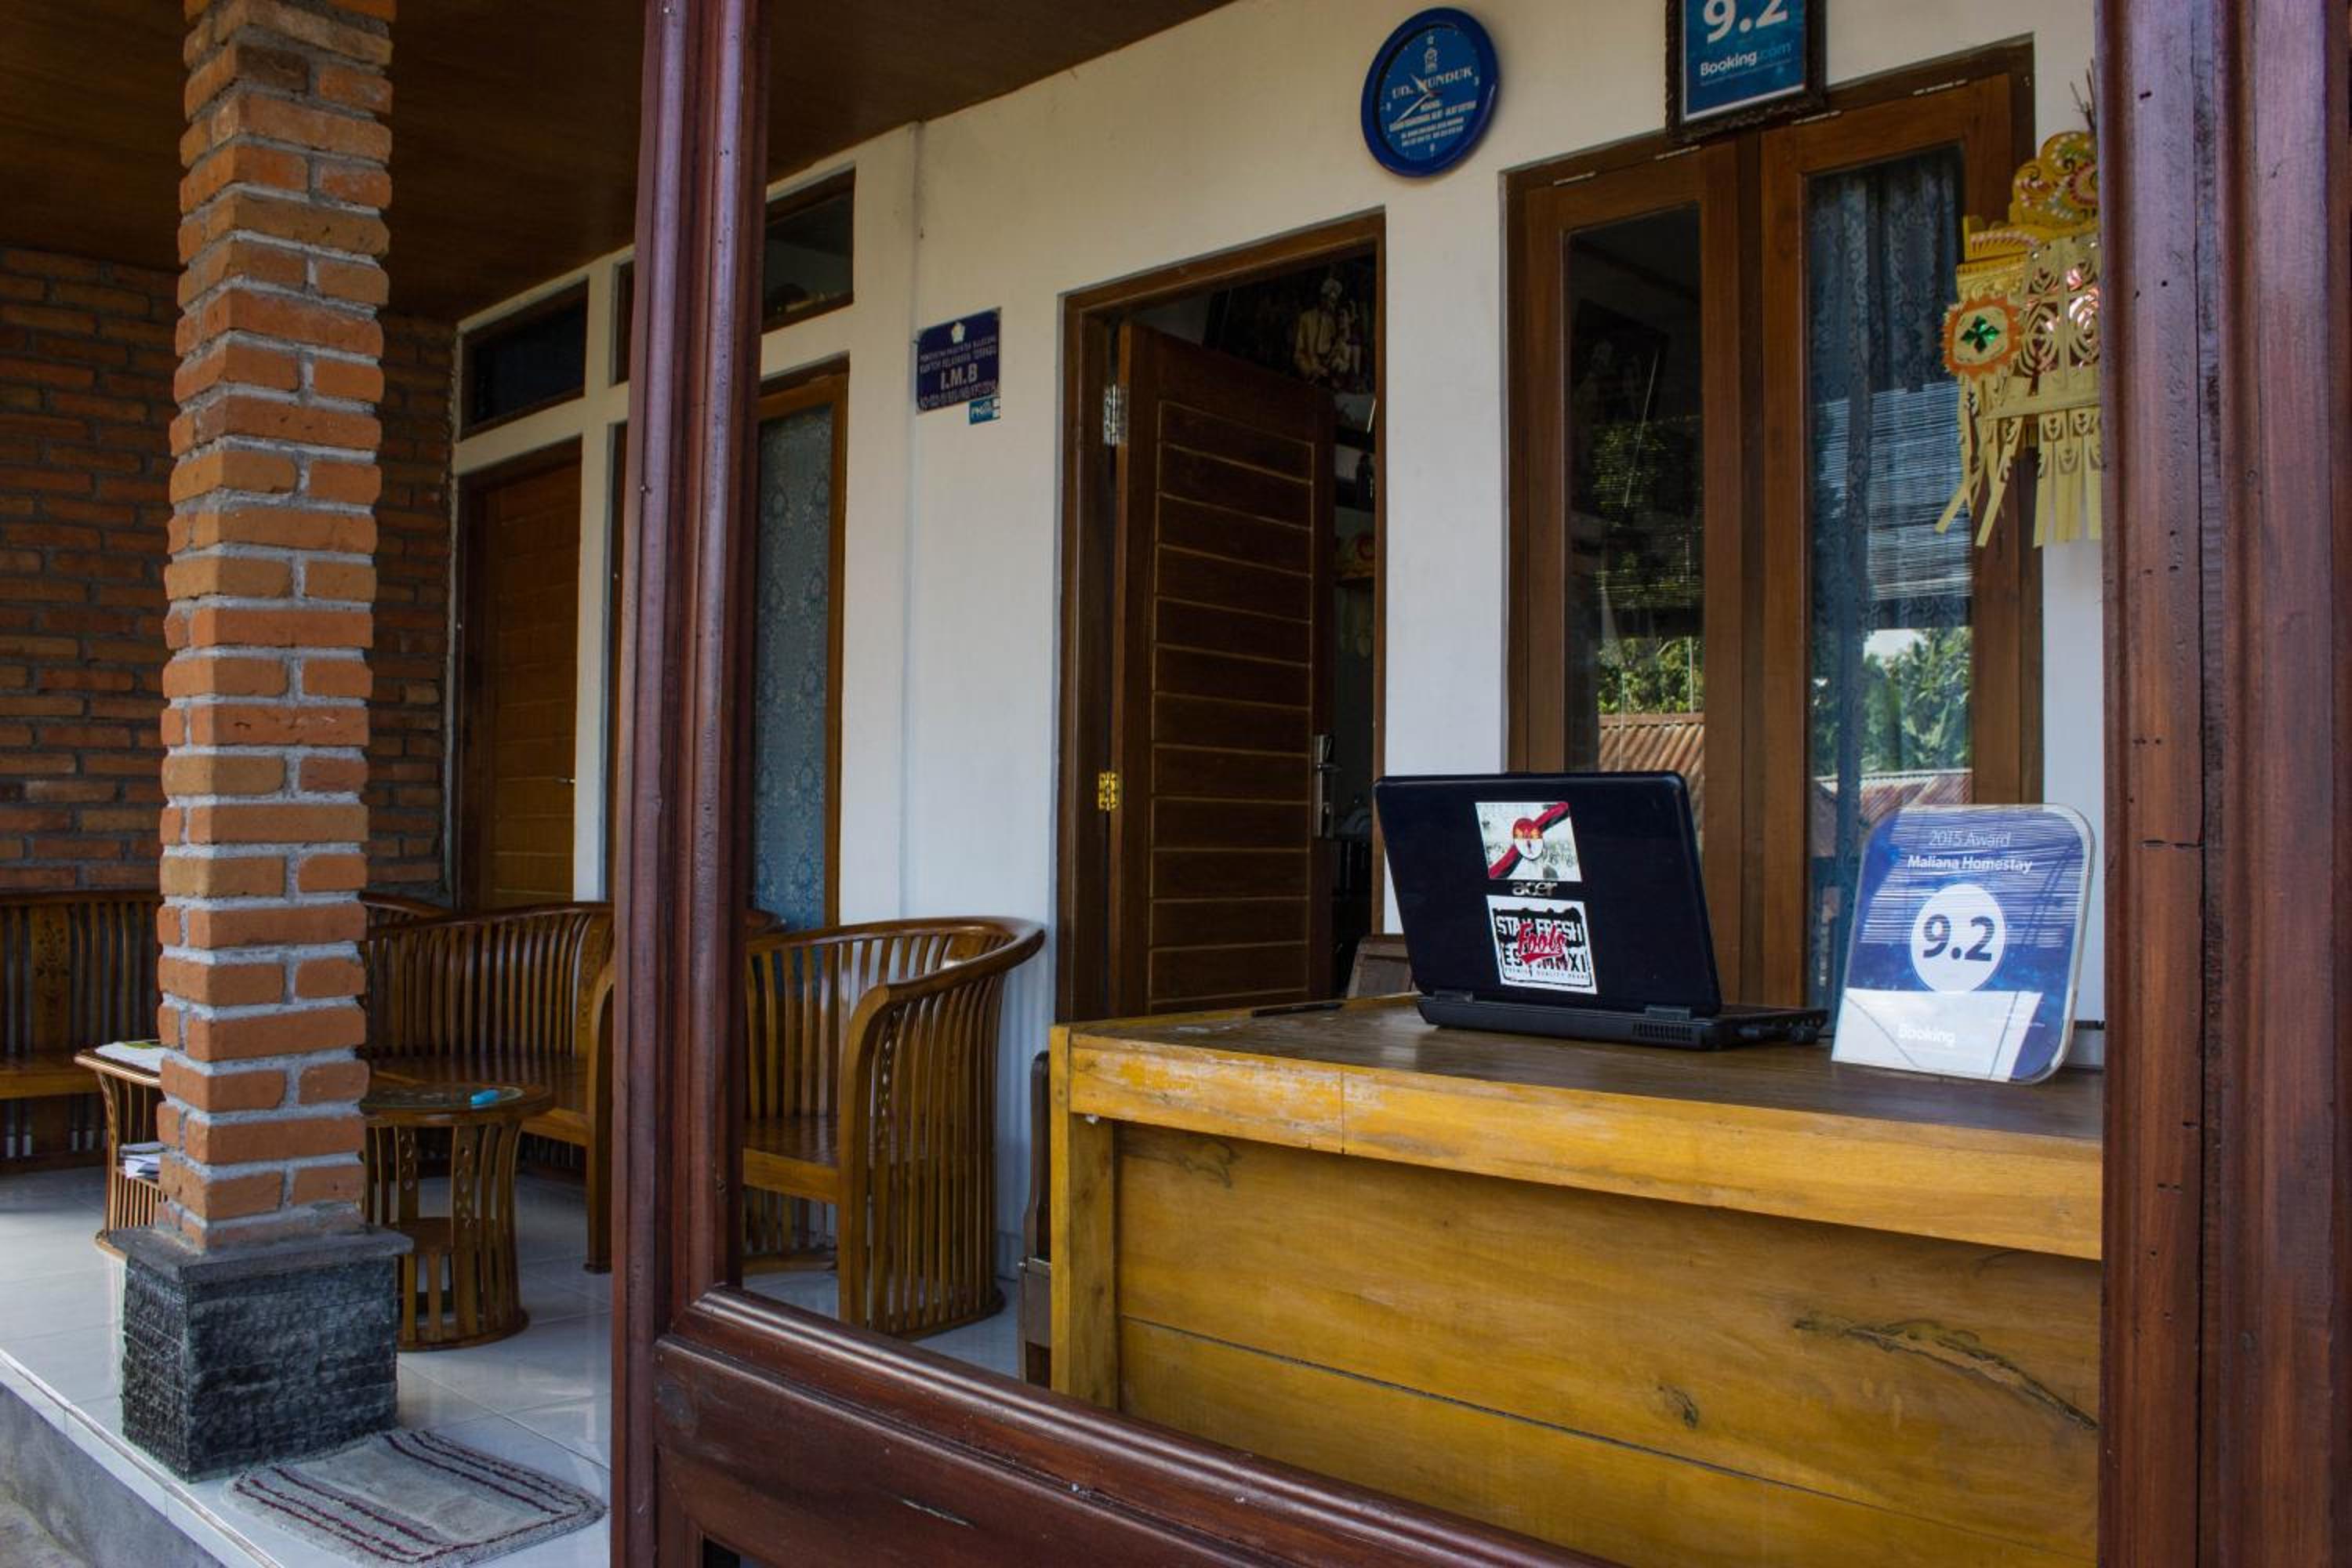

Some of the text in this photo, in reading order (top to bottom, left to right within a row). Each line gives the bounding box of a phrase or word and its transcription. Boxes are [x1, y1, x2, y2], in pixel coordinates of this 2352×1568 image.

[1704, 0, 1788, 43] 9.2
[1929, 829, 2012, 848] 2015 Award
[1907, 855, 2032, 874] Maliana Homestay
[1512, 881, 1558, 896] acer
[1923, 914, 1995, 961] 9.2
